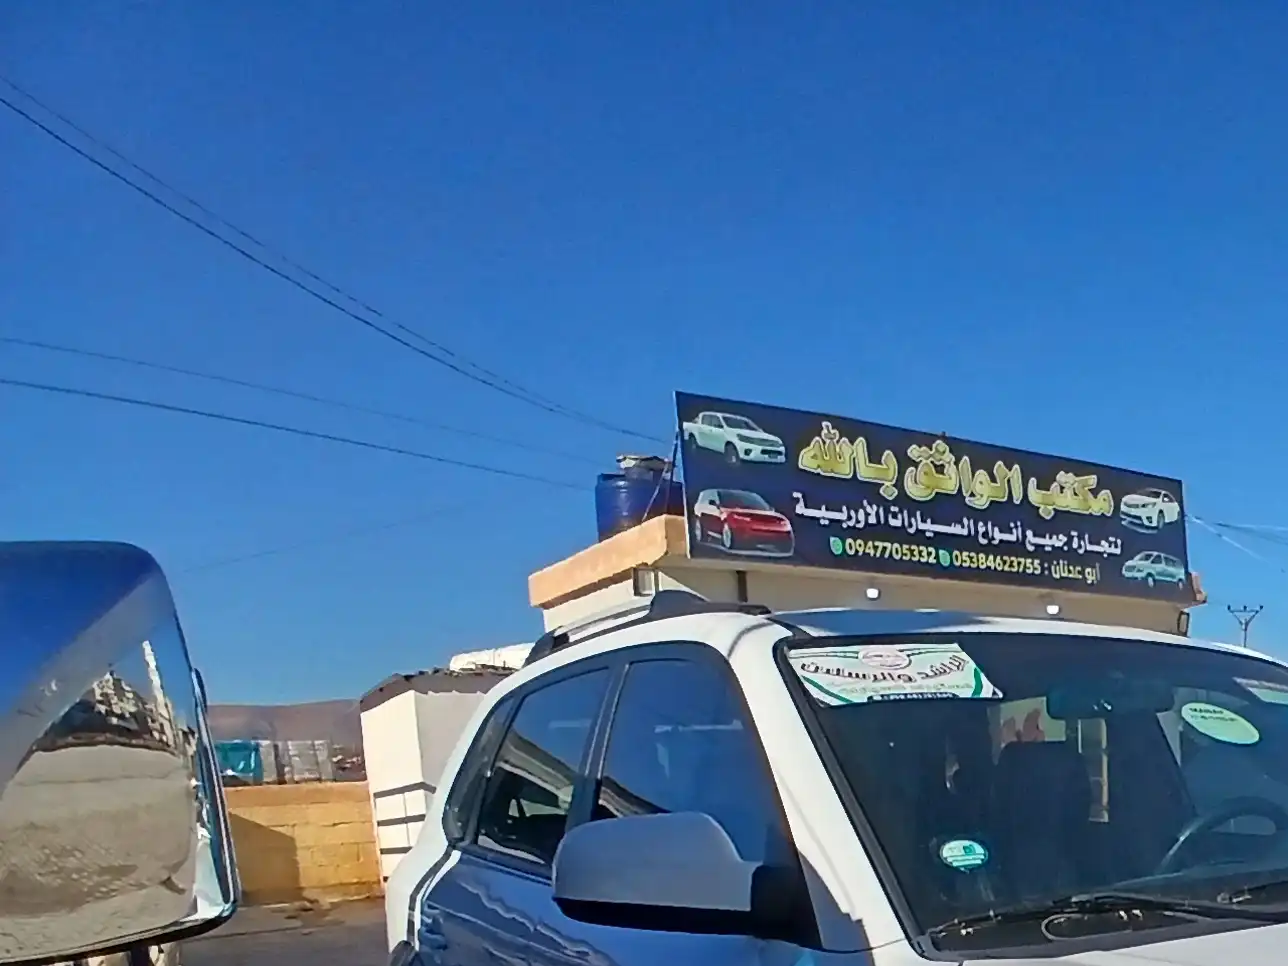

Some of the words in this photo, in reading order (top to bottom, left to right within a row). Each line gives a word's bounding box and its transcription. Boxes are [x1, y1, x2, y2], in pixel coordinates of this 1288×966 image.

[904, 440, 1023, 510] الواثق
[1027, 470, 1114, 520] مكتب
[888, 505, 974, 537] السيارات
[844, 537, 937, 564] 0947705332
[1025, 529, 1067, 551] جميع
[1070, 530, 1122, 557] لتجارة
[952, 550, 1041, 575] 05384623755
[1051, 559, 1083, 580] عدنان
